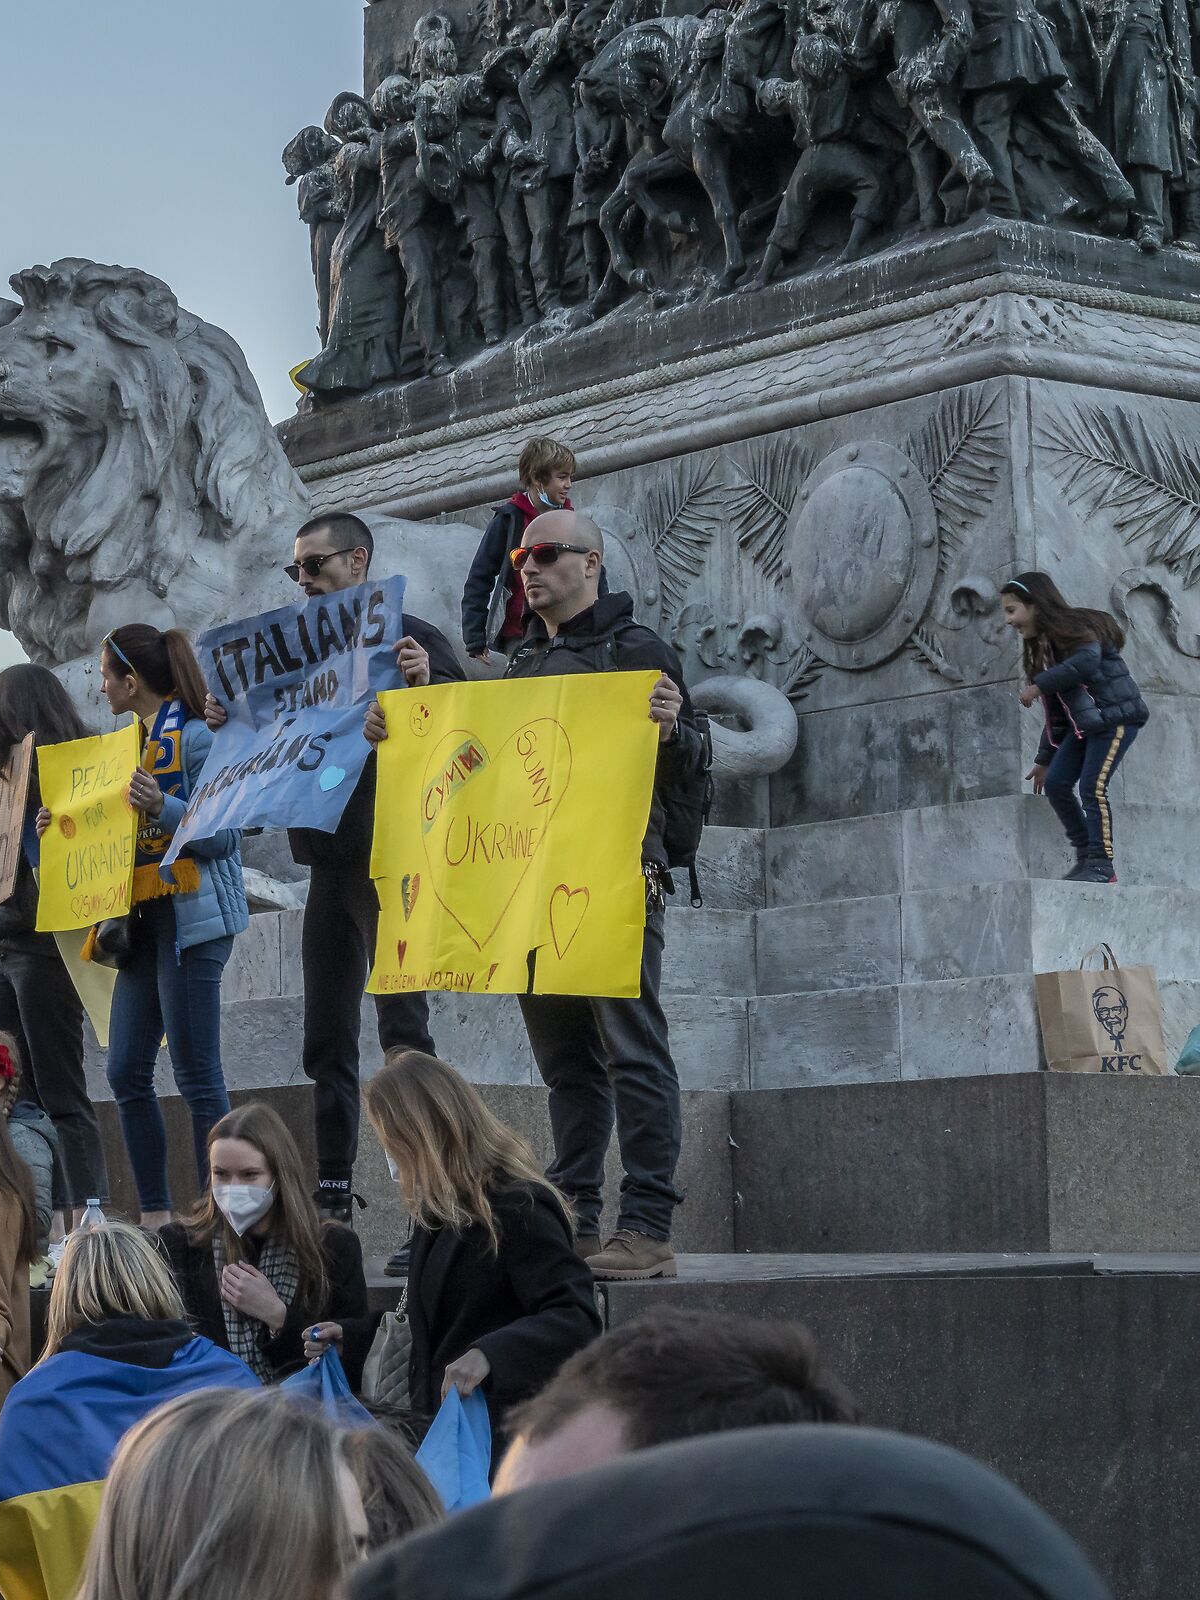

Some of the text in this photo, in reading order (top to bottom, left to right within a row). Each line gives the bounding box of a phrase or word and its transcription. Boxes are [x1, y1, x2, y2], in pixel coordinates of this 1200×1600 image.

[212, 590, 385, 701] ITALIANS
[273, 669, 339, 720] STAND
[69, 752, 127, 803] PEACE
[516, 730, 553, 808] SUMY
[83, 802, 108, 830] FOR
[1101, 1055, 1142, 1072] KFC
[319, 1180, 349, 1189] VANS
